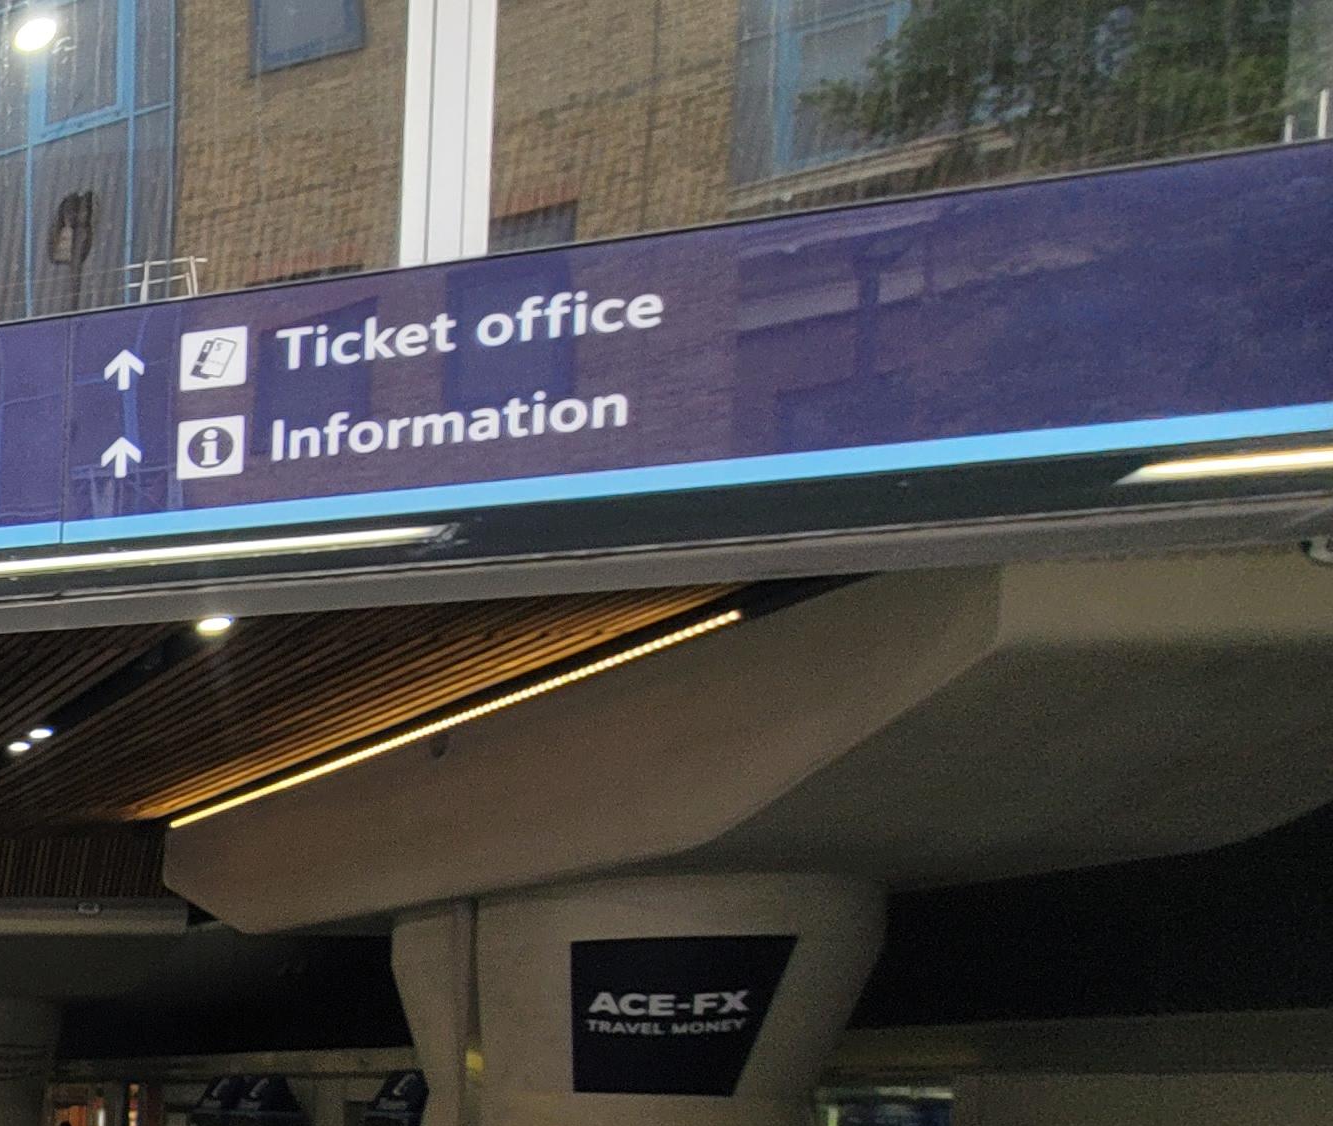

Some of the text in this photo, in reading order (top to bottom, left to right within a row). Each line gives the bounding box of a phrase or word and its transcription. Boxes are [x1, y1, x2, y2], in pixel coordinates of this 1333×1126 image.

[276, 291, 664, 371] Ticket office
[271, 390, 629, 462] Information
[587, 1017, 747, 1035] TRAVEL MONEY
[588, 990, 749, 1017] ACE-FX
